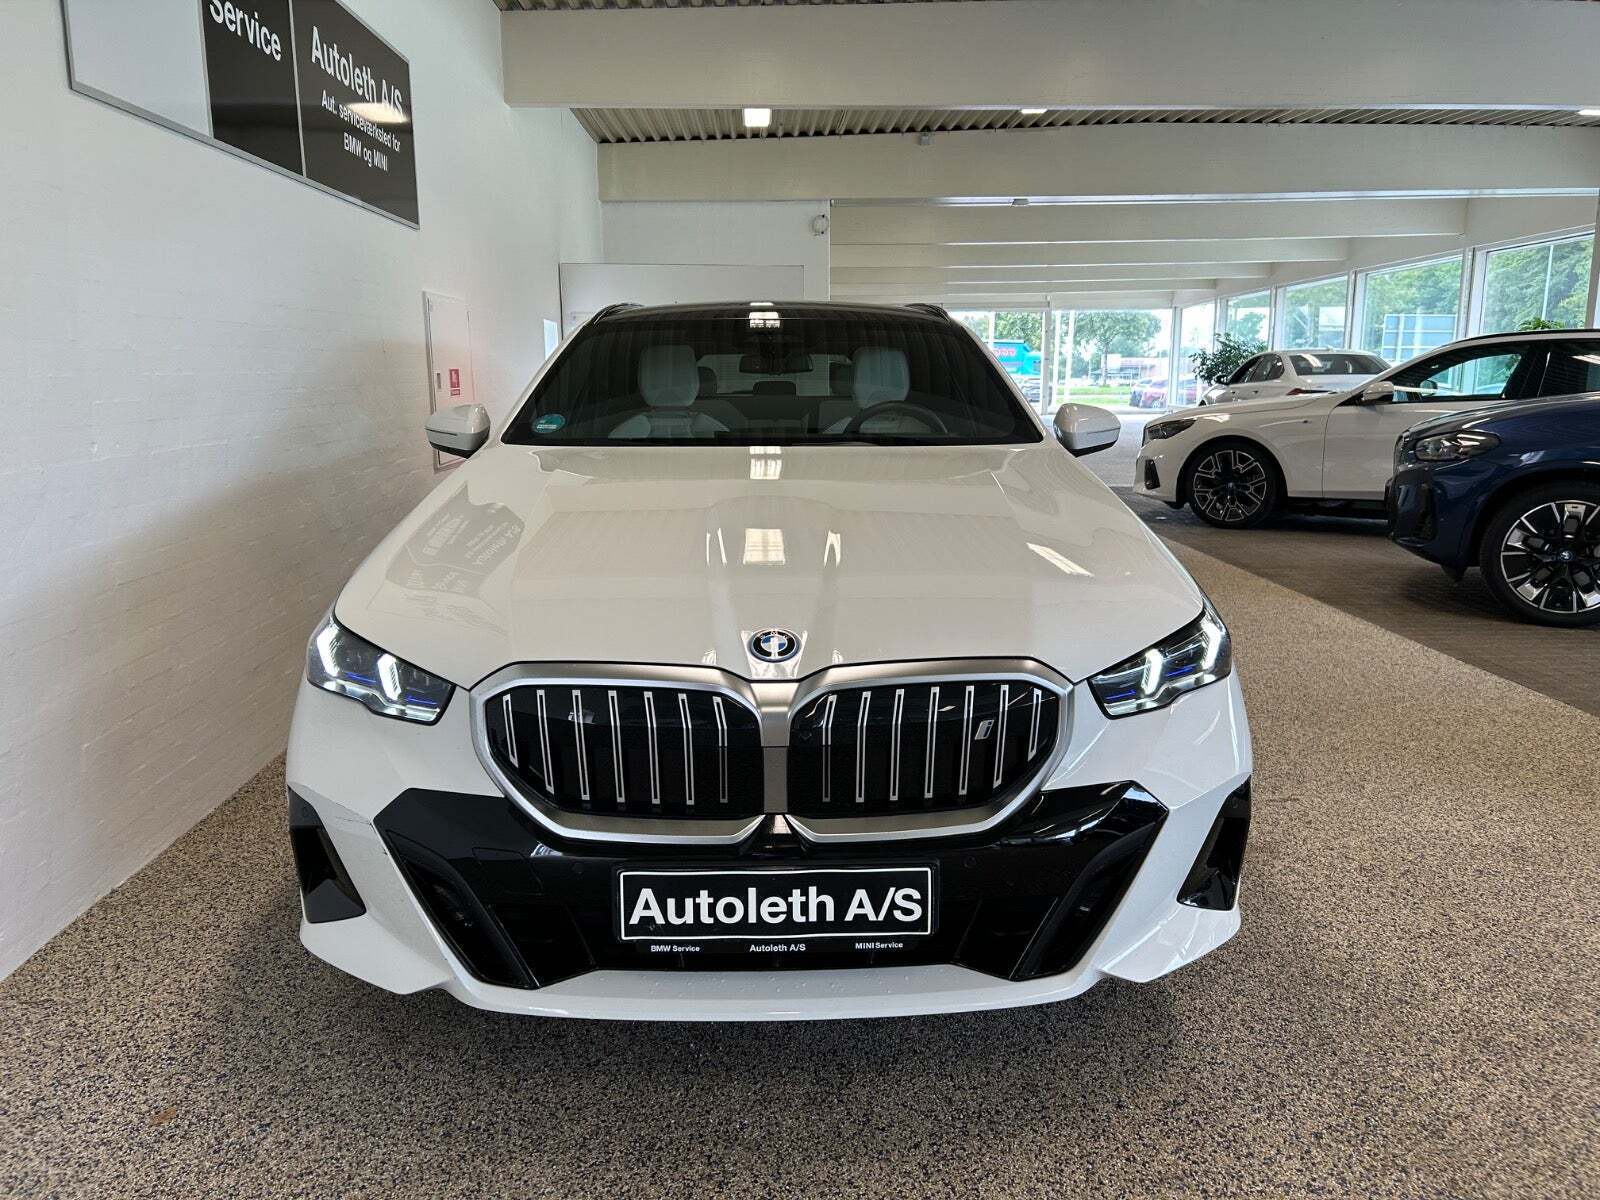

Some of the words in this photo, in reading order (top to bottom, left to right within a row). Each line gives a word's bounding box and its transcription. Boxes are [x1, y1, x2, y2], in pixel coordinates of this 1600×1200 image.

[312, 26, 377, 104] Autoleth
[382, 79, 403, 118] A/S
[322, 89, 337, 114] Aut.
[393, 134, 401, 152] for
[344, 132, 362, 157] BMW
[363, 147, 372, 168] og
[374, 149, 388, 171] MINI
[628, 886, 835, 925] Autoleth
[844, 887, 922, 922] A/S
[749, 944, 787, 952] Autoleth
[789, 943, 806, 951] A/S
[875, 941, 904, 949] Service
